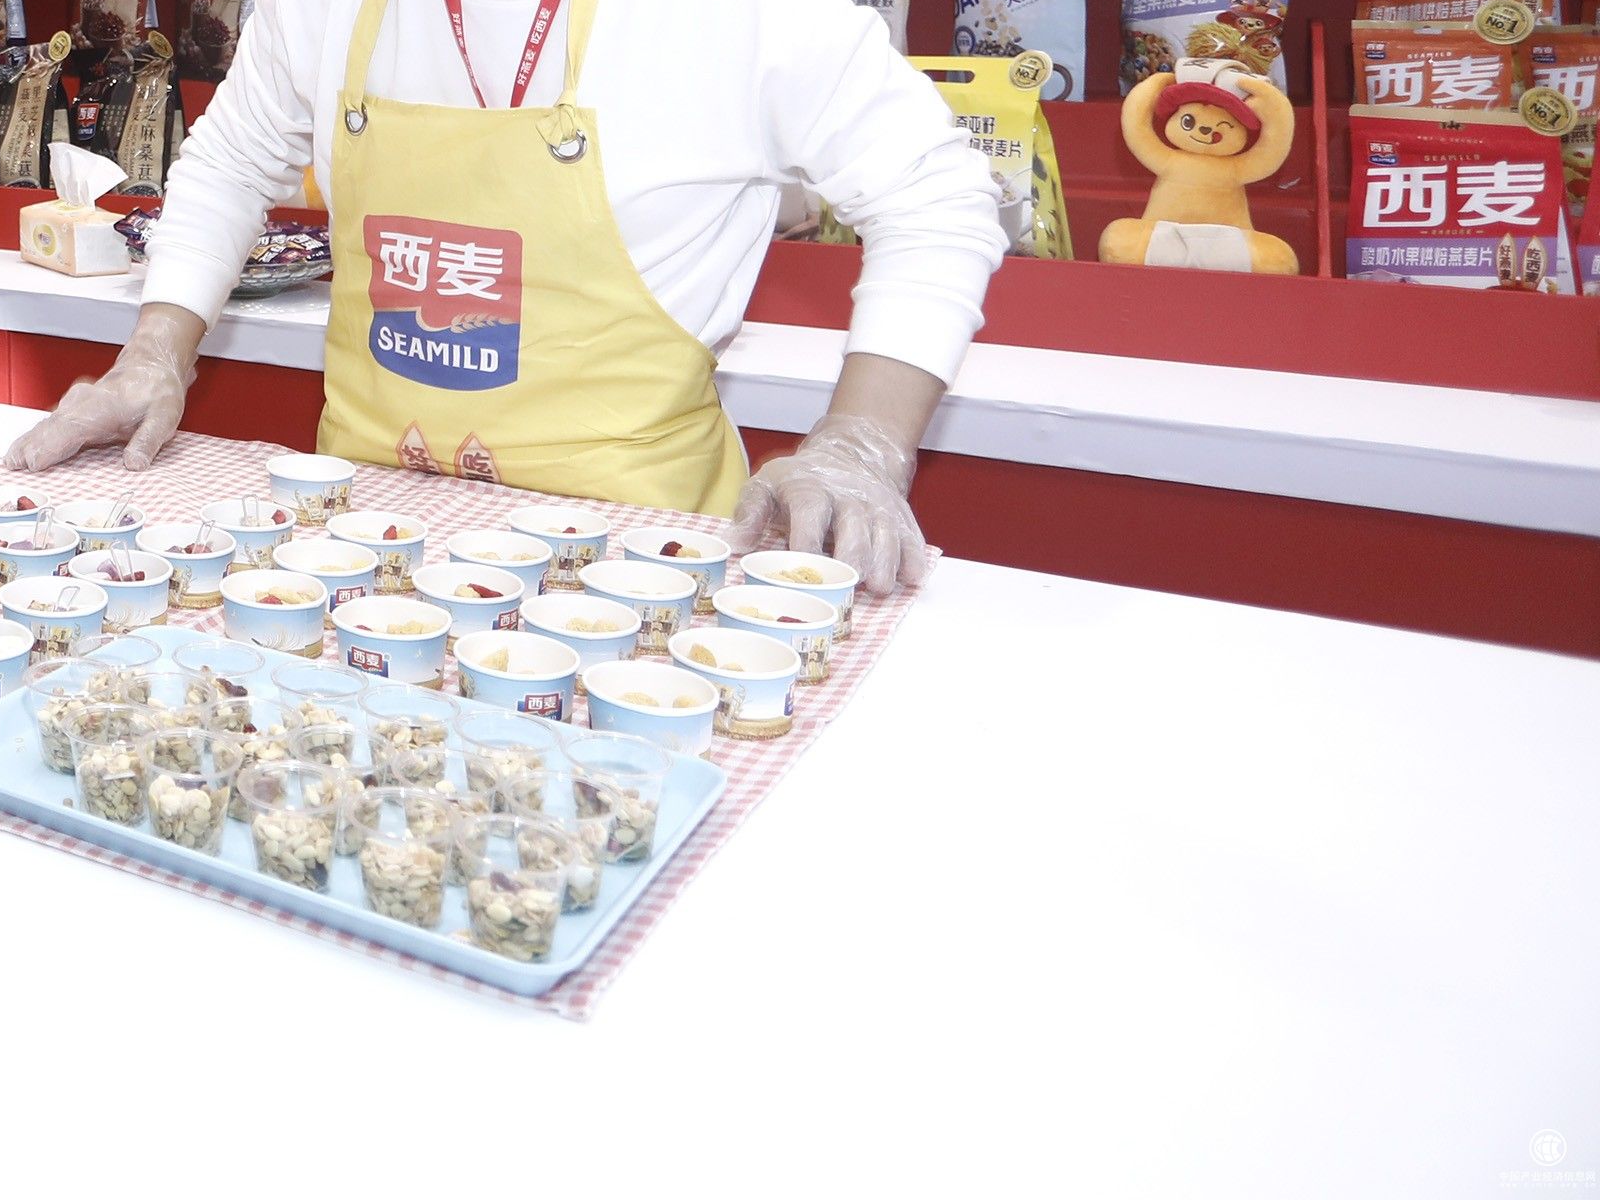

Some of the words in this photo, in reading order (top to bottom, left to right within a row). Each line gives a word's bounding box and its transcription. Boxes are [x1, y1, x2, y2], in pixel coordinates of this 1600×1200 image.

[1486, 15, 1518, 34] No.1
[1365, 55, 1503, 106] 西麦
[1529, 102, 1562, 127] No.1
[1363, 161, 1545, 228] 西麦
[379, 231, 504, 301] 西麦
[1361, 246, 1493, 267] 酸奶水果烘焙燕麦片
[377, 326, 499, 373] SEAMILD
[354, 652, 379, 669] 西麦
[527, 695, 561, 712] 西麦
